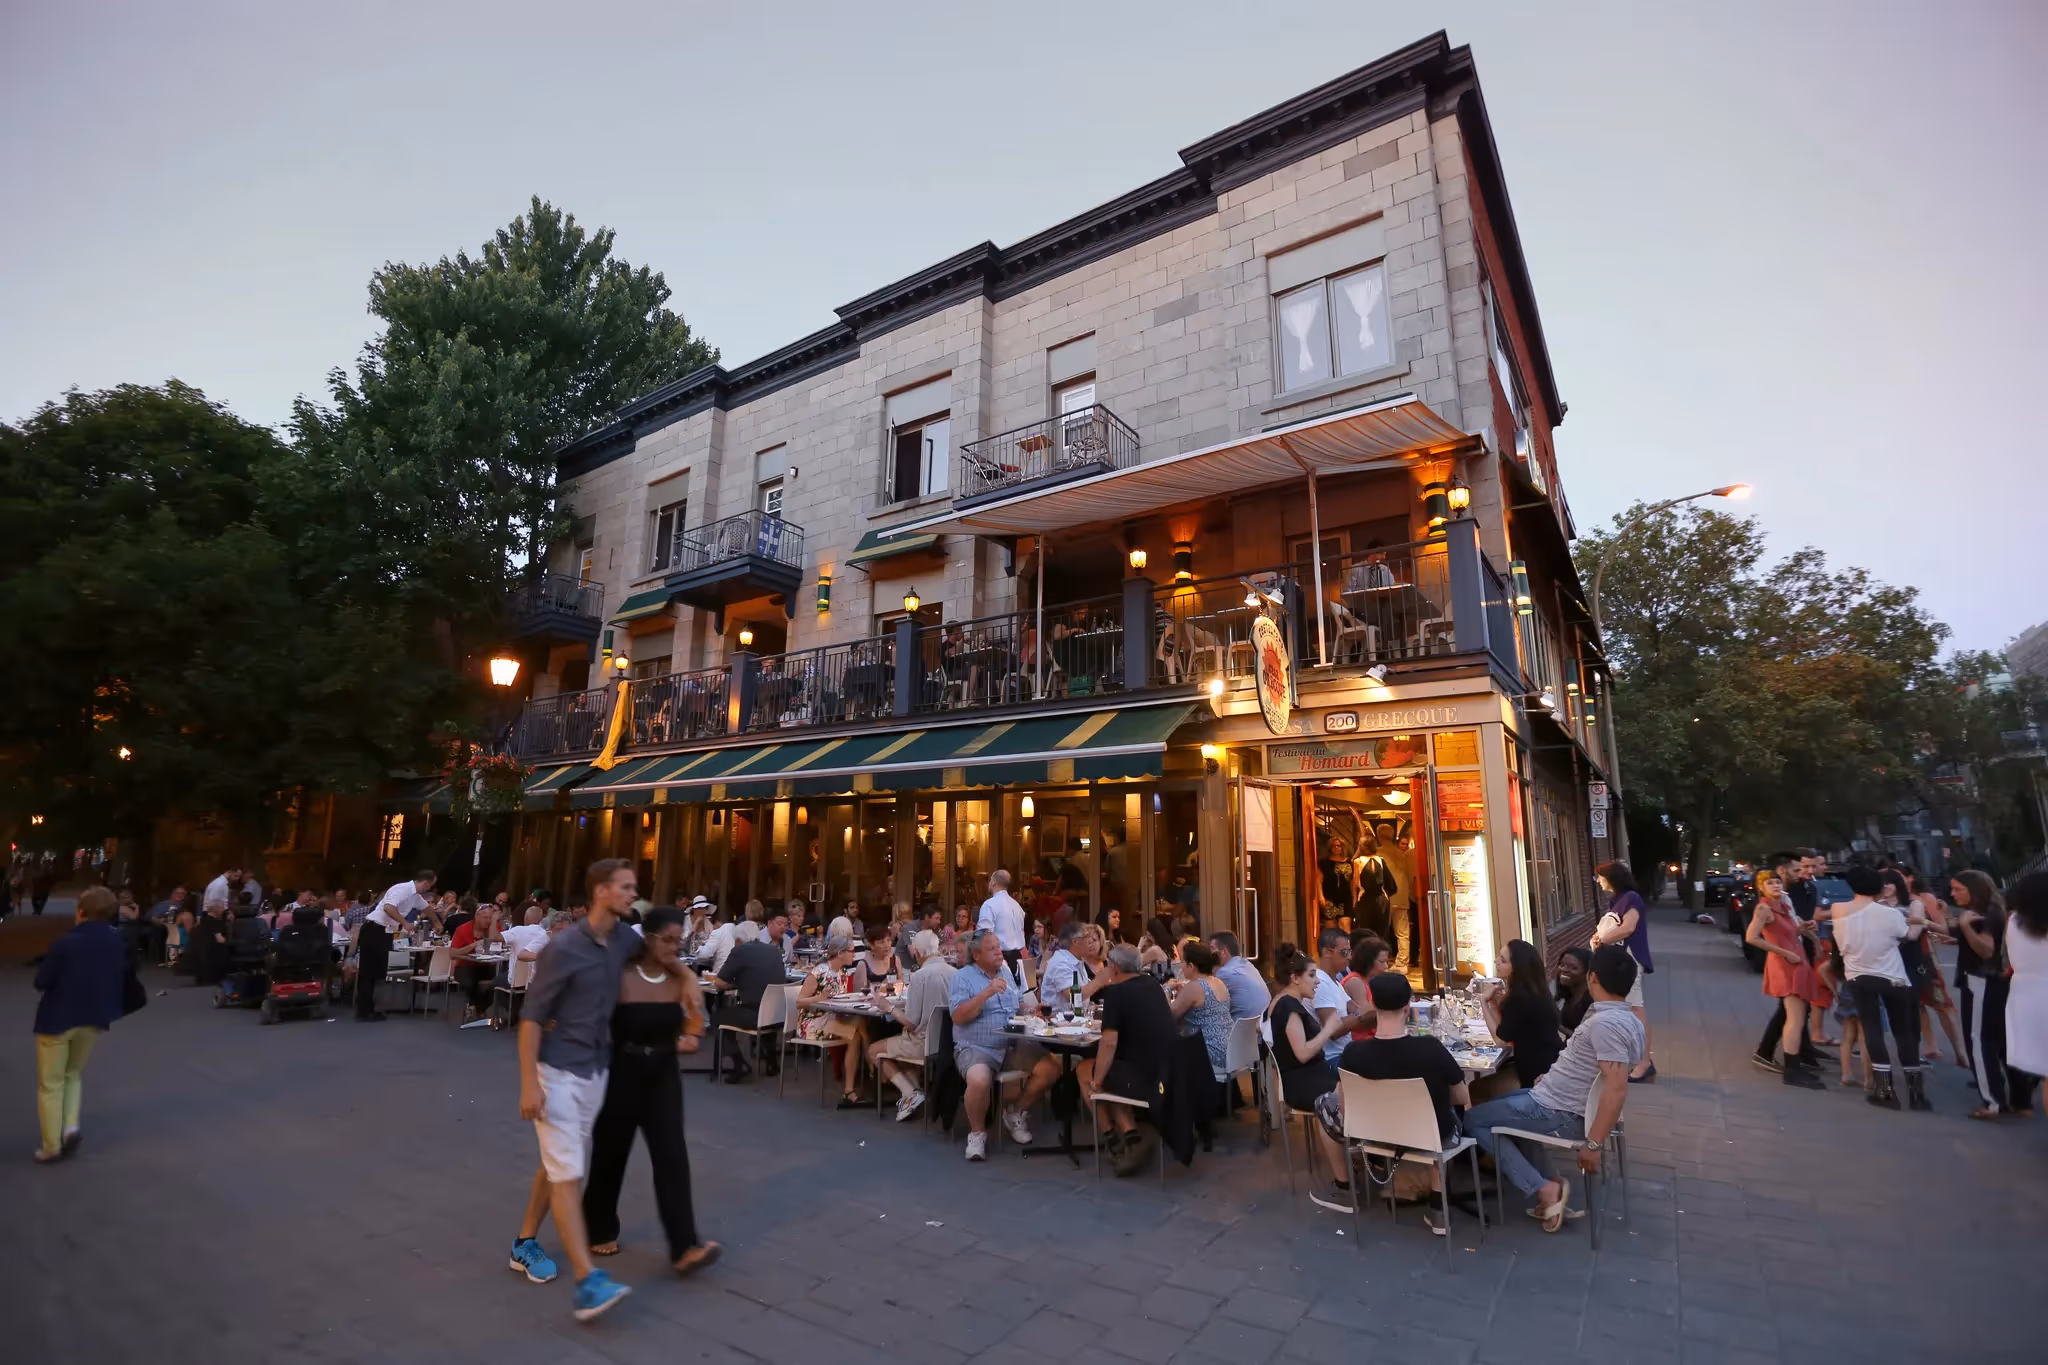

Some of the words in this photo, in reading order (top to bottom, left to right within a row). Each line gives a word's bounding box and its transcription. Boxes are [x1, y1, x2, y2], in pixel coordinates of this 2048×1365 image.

[1326, 715, 1355, 729] 200
[1363, 706, 1458, 730] GRECQUE
[1272, 747, 1310, 758] Festival
[1298, 750, 1371, 771] Homard
